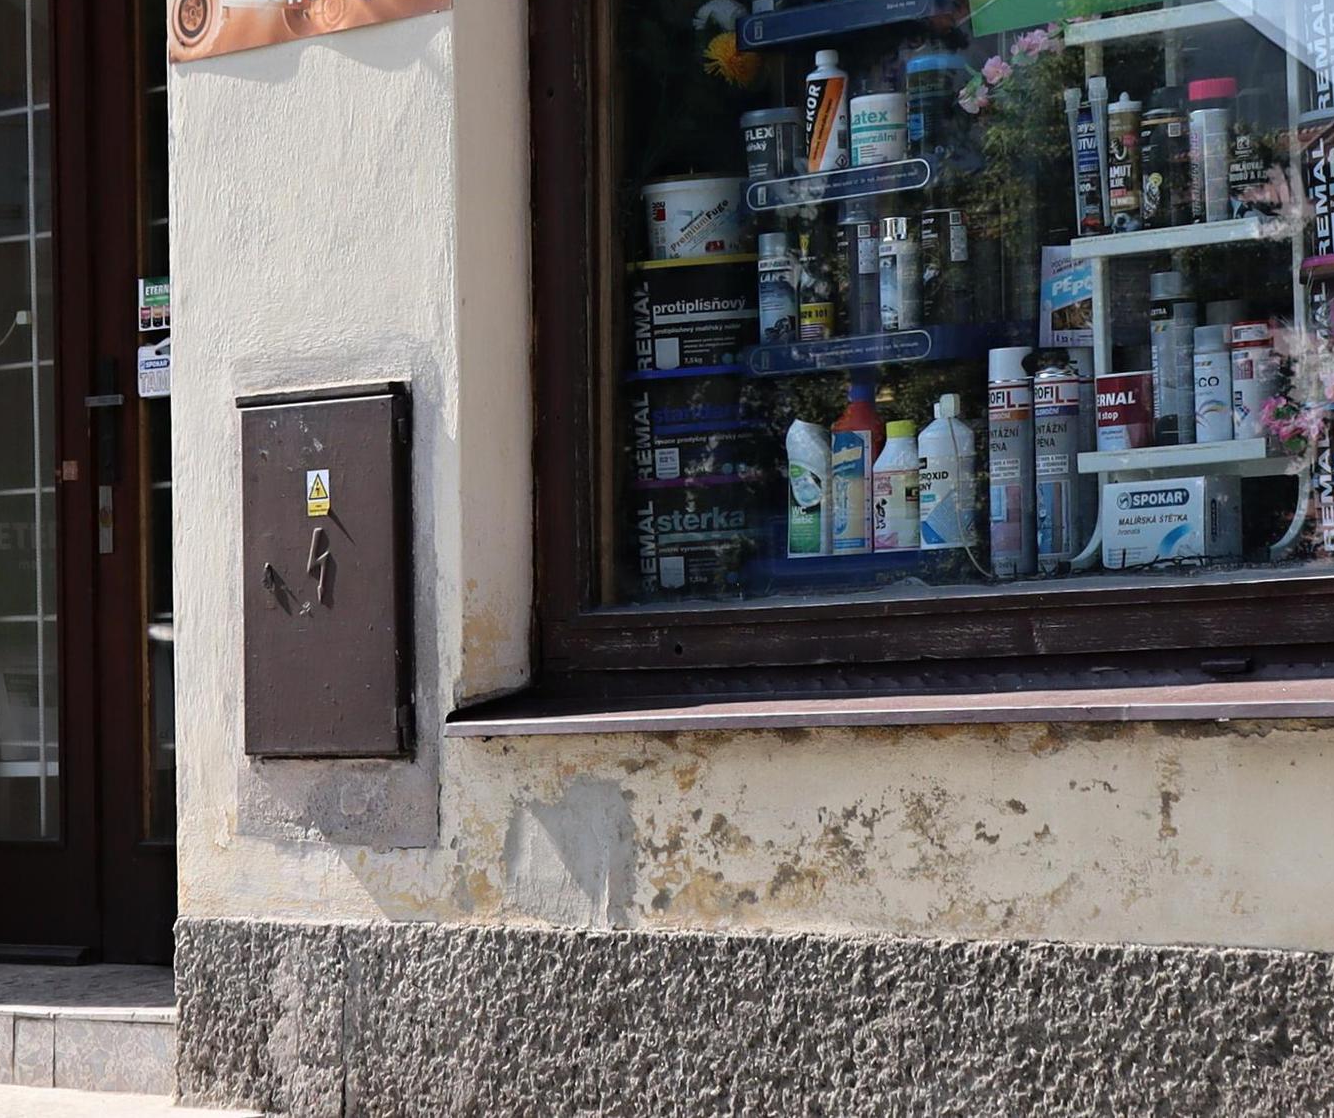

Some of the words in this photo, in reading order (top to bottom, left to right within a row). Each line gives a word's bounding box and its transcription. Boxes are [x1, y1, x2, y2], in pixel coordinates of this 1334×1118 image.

[1312, 137, 1331, 256] REMAL
[653, 295, 747, 315] protiplísňový
[634, 391, 653, 482] REMAL
[1132, 490, 1184, 507] SPOKAR
